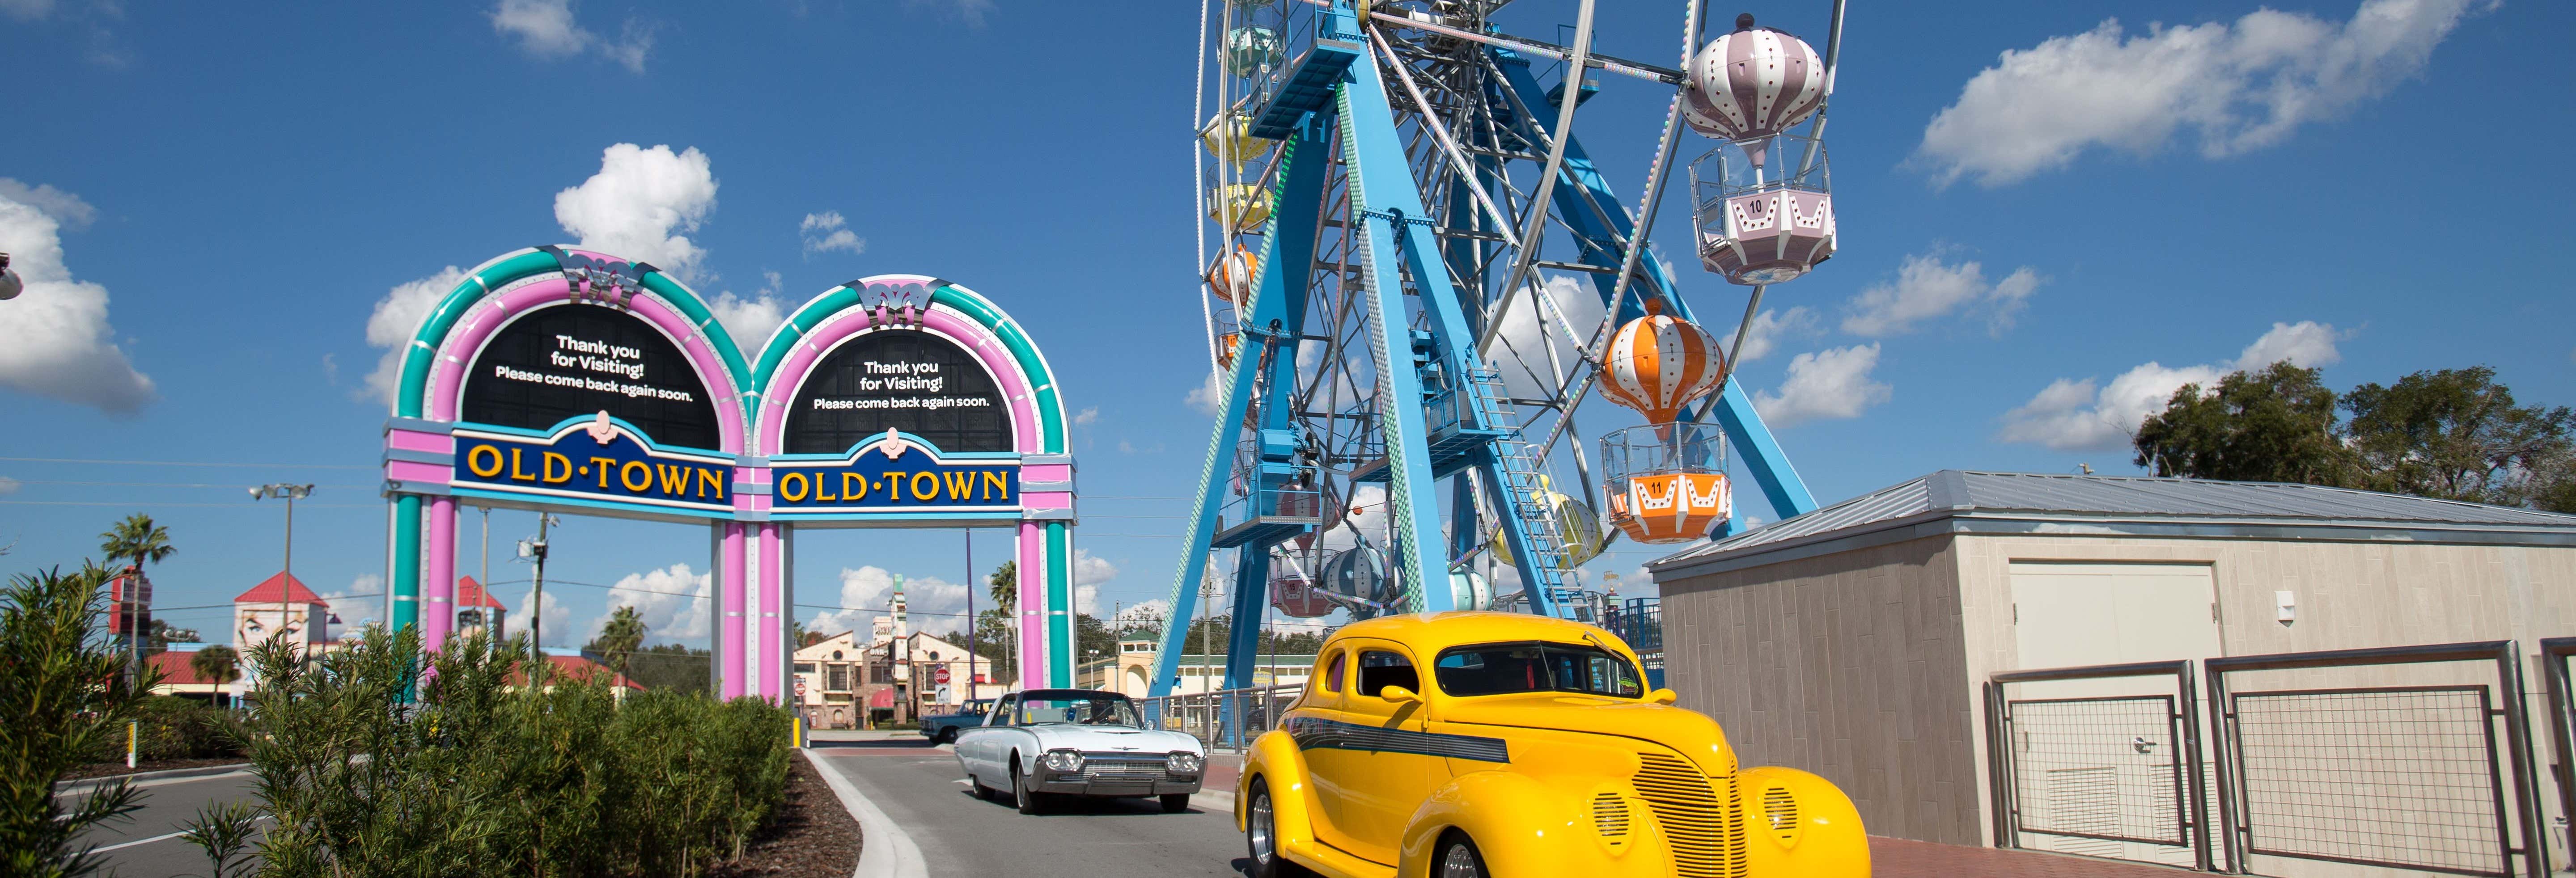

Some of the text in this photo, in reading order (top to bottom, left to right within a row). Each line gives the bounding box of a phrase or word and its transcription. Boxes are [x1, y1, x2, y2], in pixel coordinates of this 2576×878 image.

[1750, 199, 1762, 214] 10
[556, 335, 640, 359] Thank you
[551, 351, 644, 380] for Visiting!
[864, 361, 939, 376] Thank you
[496, 366, 693, 402] Please come back again soon.
[860, 376, 943, 393] for Visiting!
[814, 396, 990, 410] Please come back again soon.
[1651, 482, 1661, 494] 11
